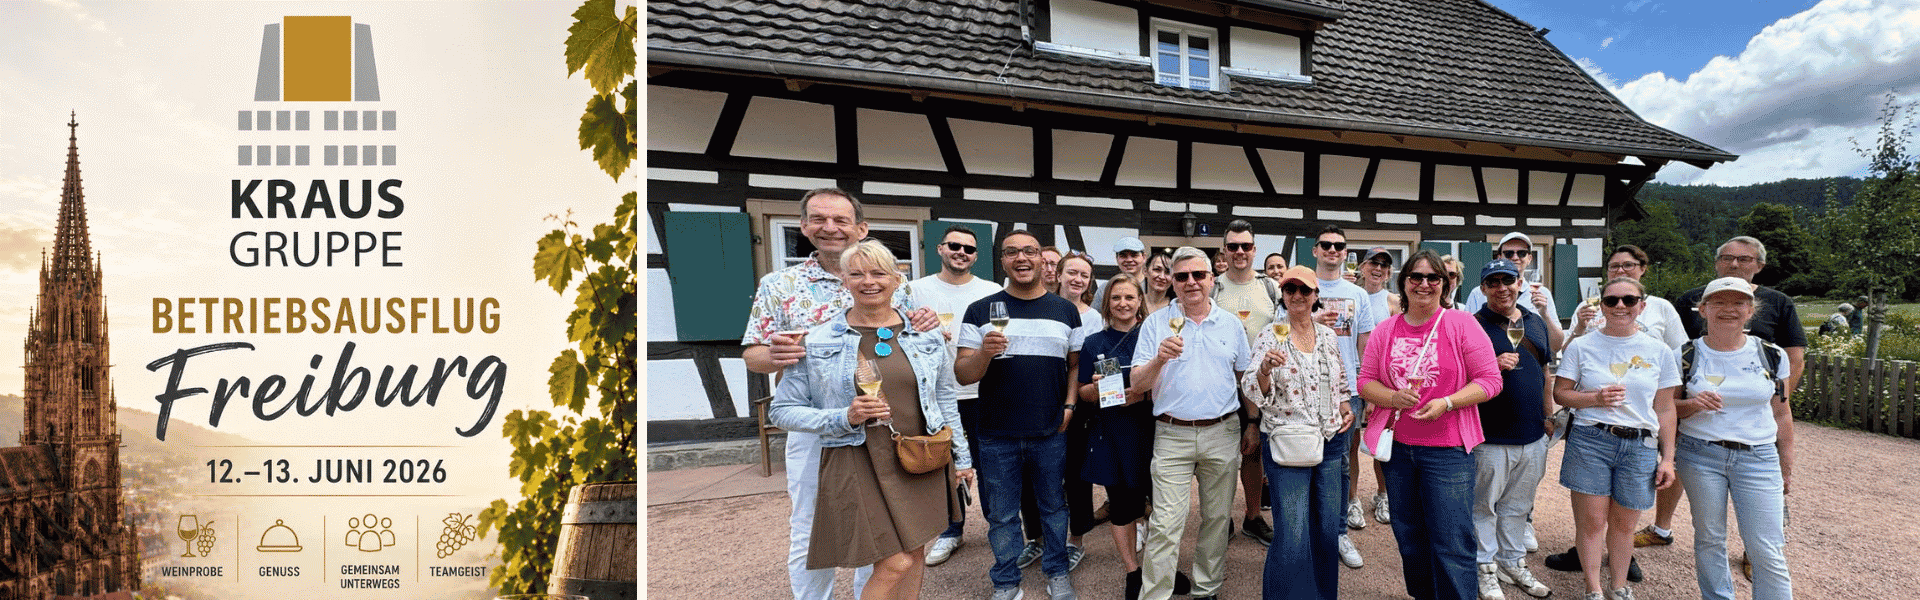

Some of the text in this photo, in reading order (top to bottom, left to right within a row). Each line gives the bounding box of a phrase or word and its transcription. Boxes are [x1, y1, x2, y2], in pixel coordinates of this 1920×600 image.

[230, 179, 405, 219] KRAUS
[229, 231, 403, 268] GRUPPE
[152, 297, 501, 335] BETRIEBSAUSFLUG
[146, 341, 508, 442] Freiburg
[308, 459, 372, 484] JUNI
[383, 459, 447, 484] 2026
[161, 565, 223, 577] WEINPROBE
[258, 565, 300, 577] GENUSS
[340, 564, 400, 576] GEMEINSAM
[429, 565, 486, 577] TEAMGEIST
[340, 578, 400, 590] UNTERWEGS
